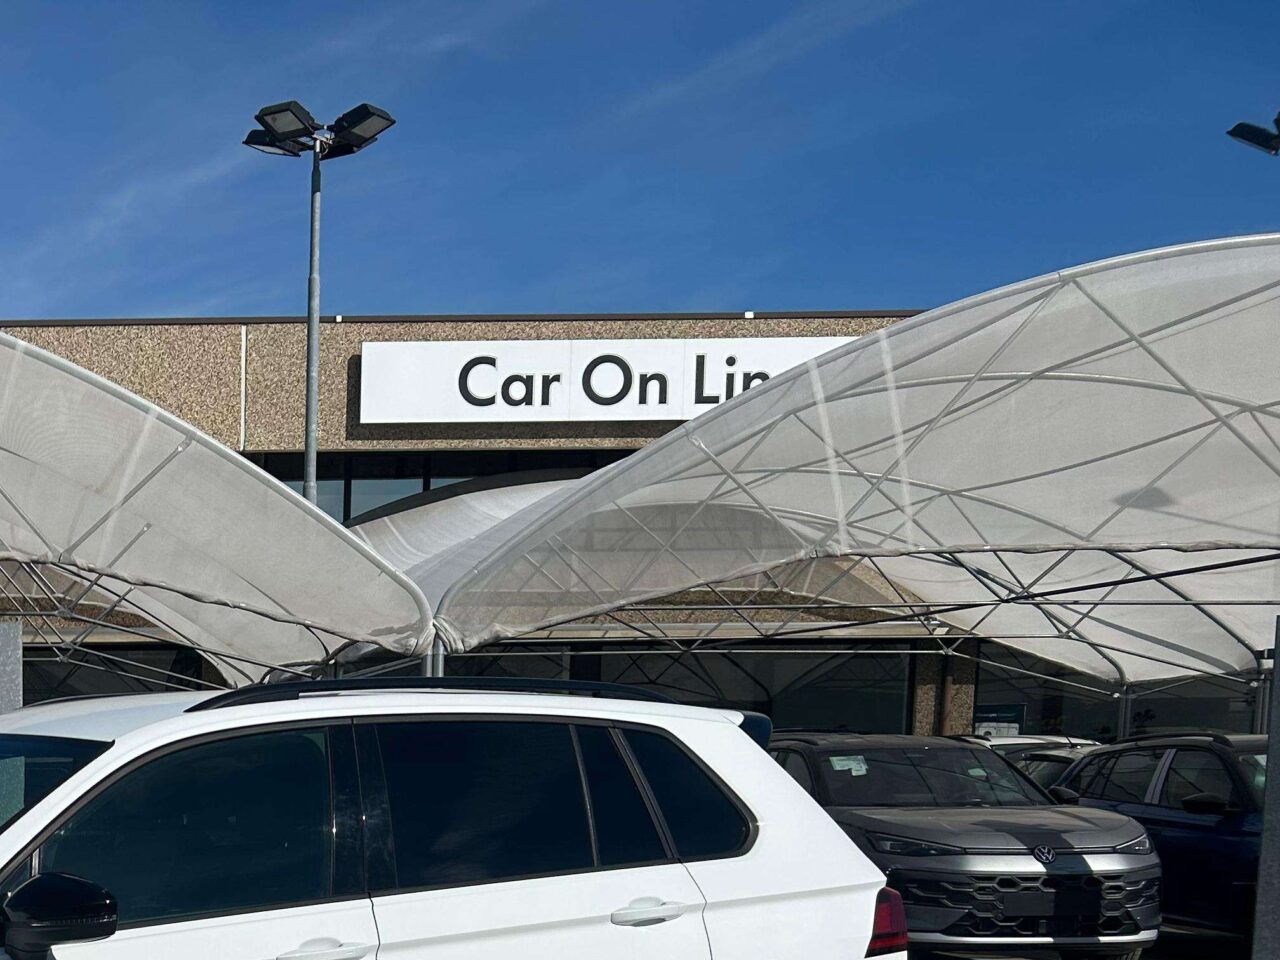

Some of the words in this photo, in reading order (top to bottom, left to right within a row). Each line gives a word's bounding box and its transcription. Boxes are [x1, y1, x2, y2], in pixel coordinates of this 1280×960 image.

[458, 355, 561, 406] Car
[582, 354, 669, 406] On
[694, 353, 771, 405] Lin
